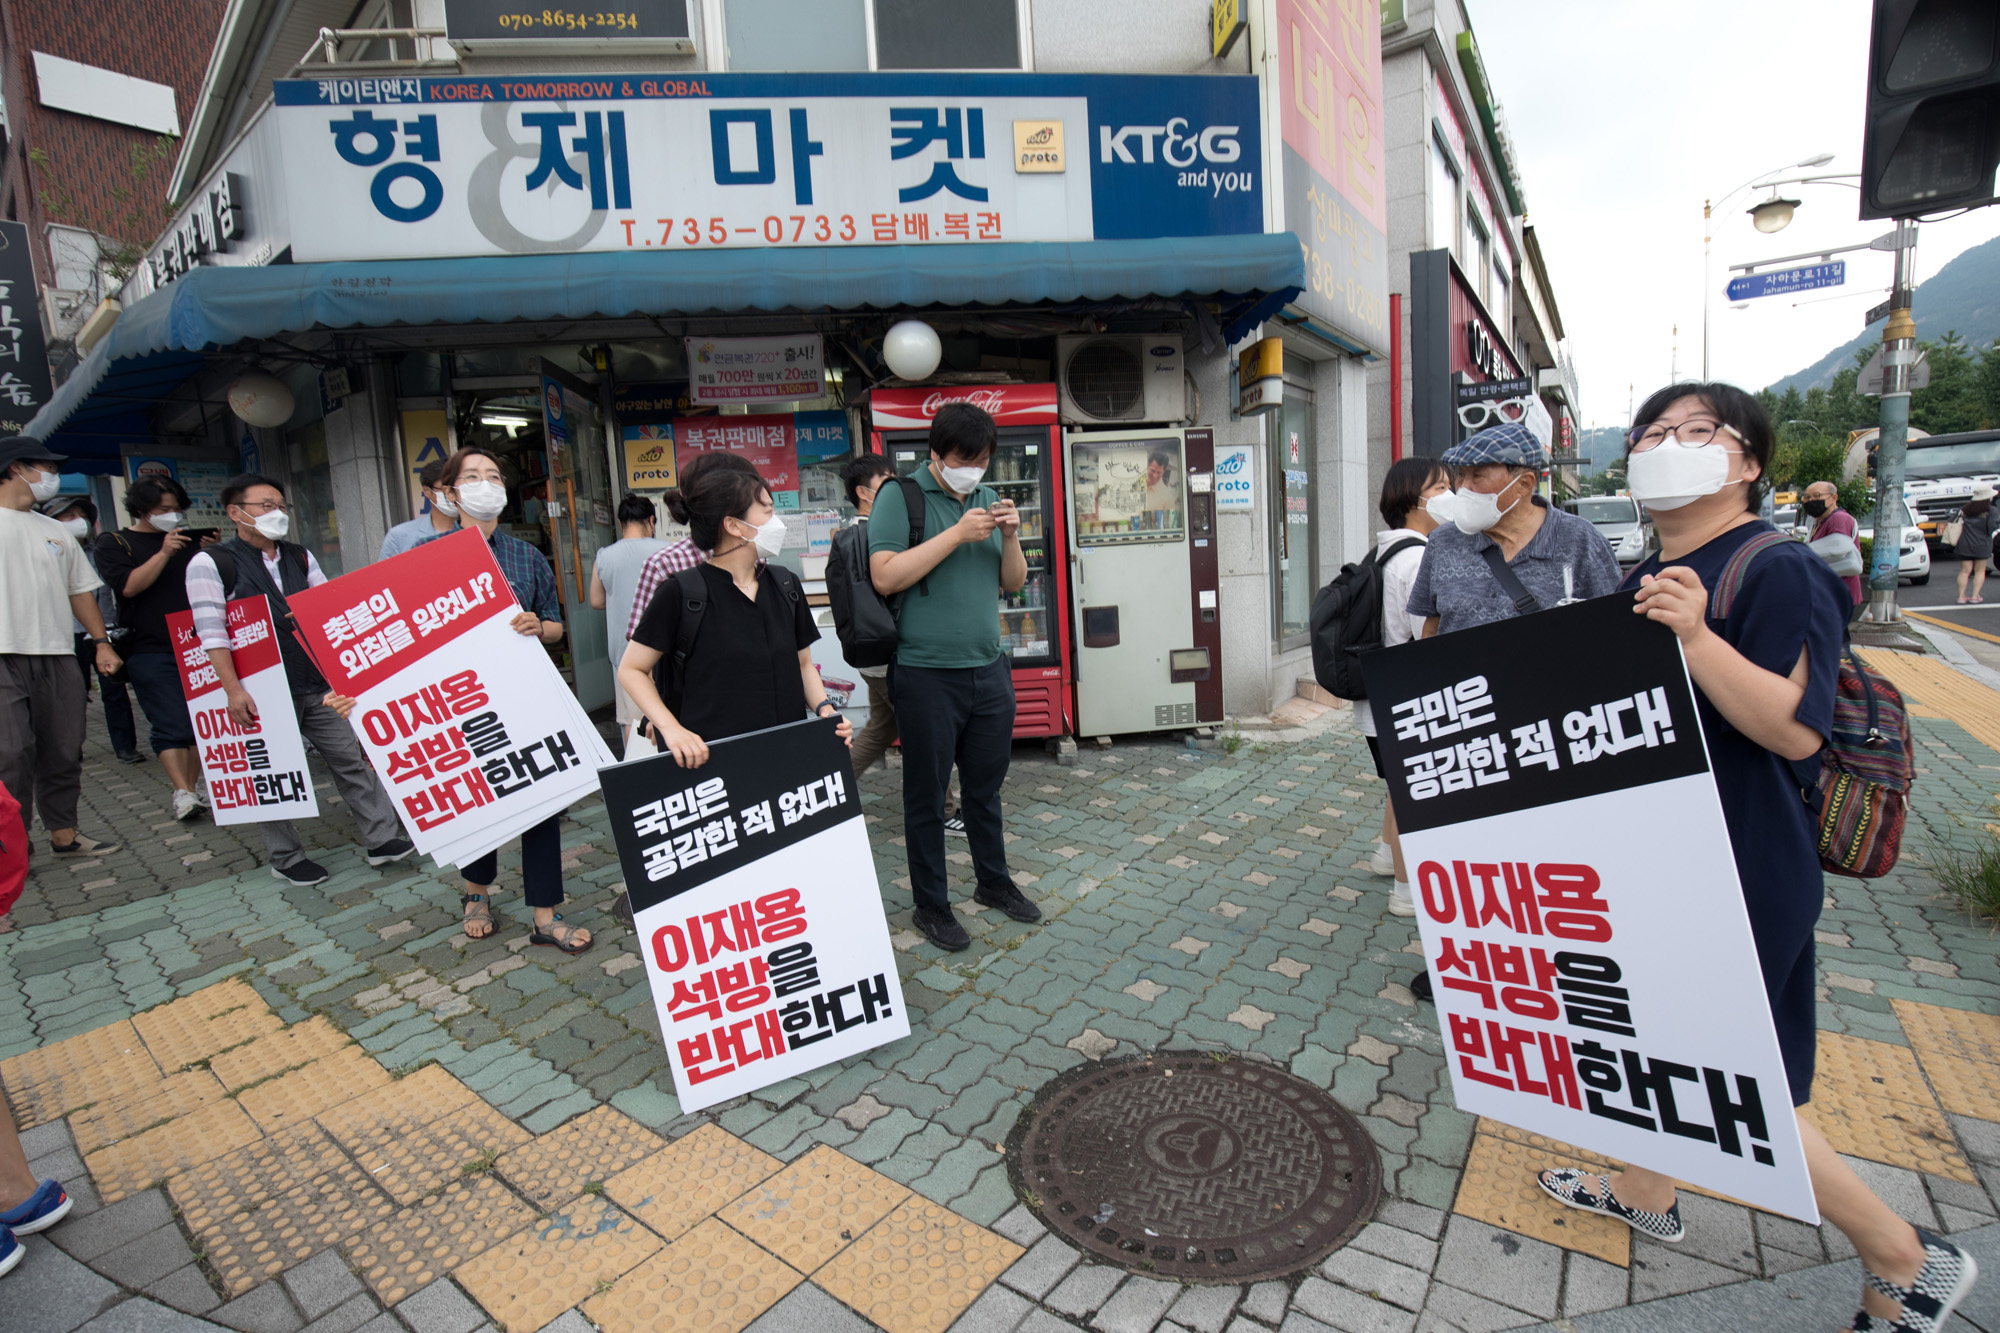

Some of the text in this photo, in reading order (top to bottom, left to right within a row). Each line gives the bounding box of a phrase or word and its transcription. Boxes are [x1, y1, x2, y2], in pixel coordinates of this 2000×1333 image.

[499, 9, 638, 31] 070-8654-2254
[318, 78, 423, 104] 케이티앤지
[430, 81, 712, 101] KOREA TOMORROW & GLOBAL
[1020, 150, 1060, 166] proto
[1101, 117, 1241, 168] KT&G
[1177, 168, 1252, 198] and you
[155, 171, 236, 288] 복권판매점
[620, 212, 1003, 247] T.735-0733 담배.복권
[1300, 241, 1383, 331] 738-0280
[1762, 276, 1842, 296] Jahamun-ro 11-gil
[1765, 263, 1842, 285] 자하문로11길
[698, 373, 716, 384] 매월
[716, 369, 754, 383] 700만
[757, 371, 774, 382] 원씩
[784, 367, 817, 381] 20년간
[784, 345, 815, 362] 출시!
[1241, 386, 1263, 410] proto
[685, 424, 786, 451] 복권판매점
[817, 426, 844, 441] 마켓
[633, 469, 670, 482] proto
[1217, 479, 1250, 491] roto
[321, 587, 400, 649] 촛불의
[339, 571, 497, 680] 외침을 잊었나?
[188, 665, 221, 691] 회계조
[361, 669, 490, 747] 이재용
[1391, 674, 1496, 745] 국민은
[204, 738, 272, 775] 석방을
[386, 710, 512, 785] 석방을
[1402, 684, 1677, 802] 공감한 적 없다!
[210, 770, 308, 810] 반대한다!
[401, 729, 581, 833] 반대한다!
[631, 776, 730, 838] 국민은
[641, 770, 847, 882] 공감한 적 없다!
[1416, 859, 1613, 944] 이재용
[650, 887, 809, 974] 이재용
[666, 940, 822, 1024] 석방을
[1435, 936, 1637, 1039] 석방을
[676, 972, 893, 1087] 반대한다!
[1447, 1012, 1776, 1168] 반대한다!
